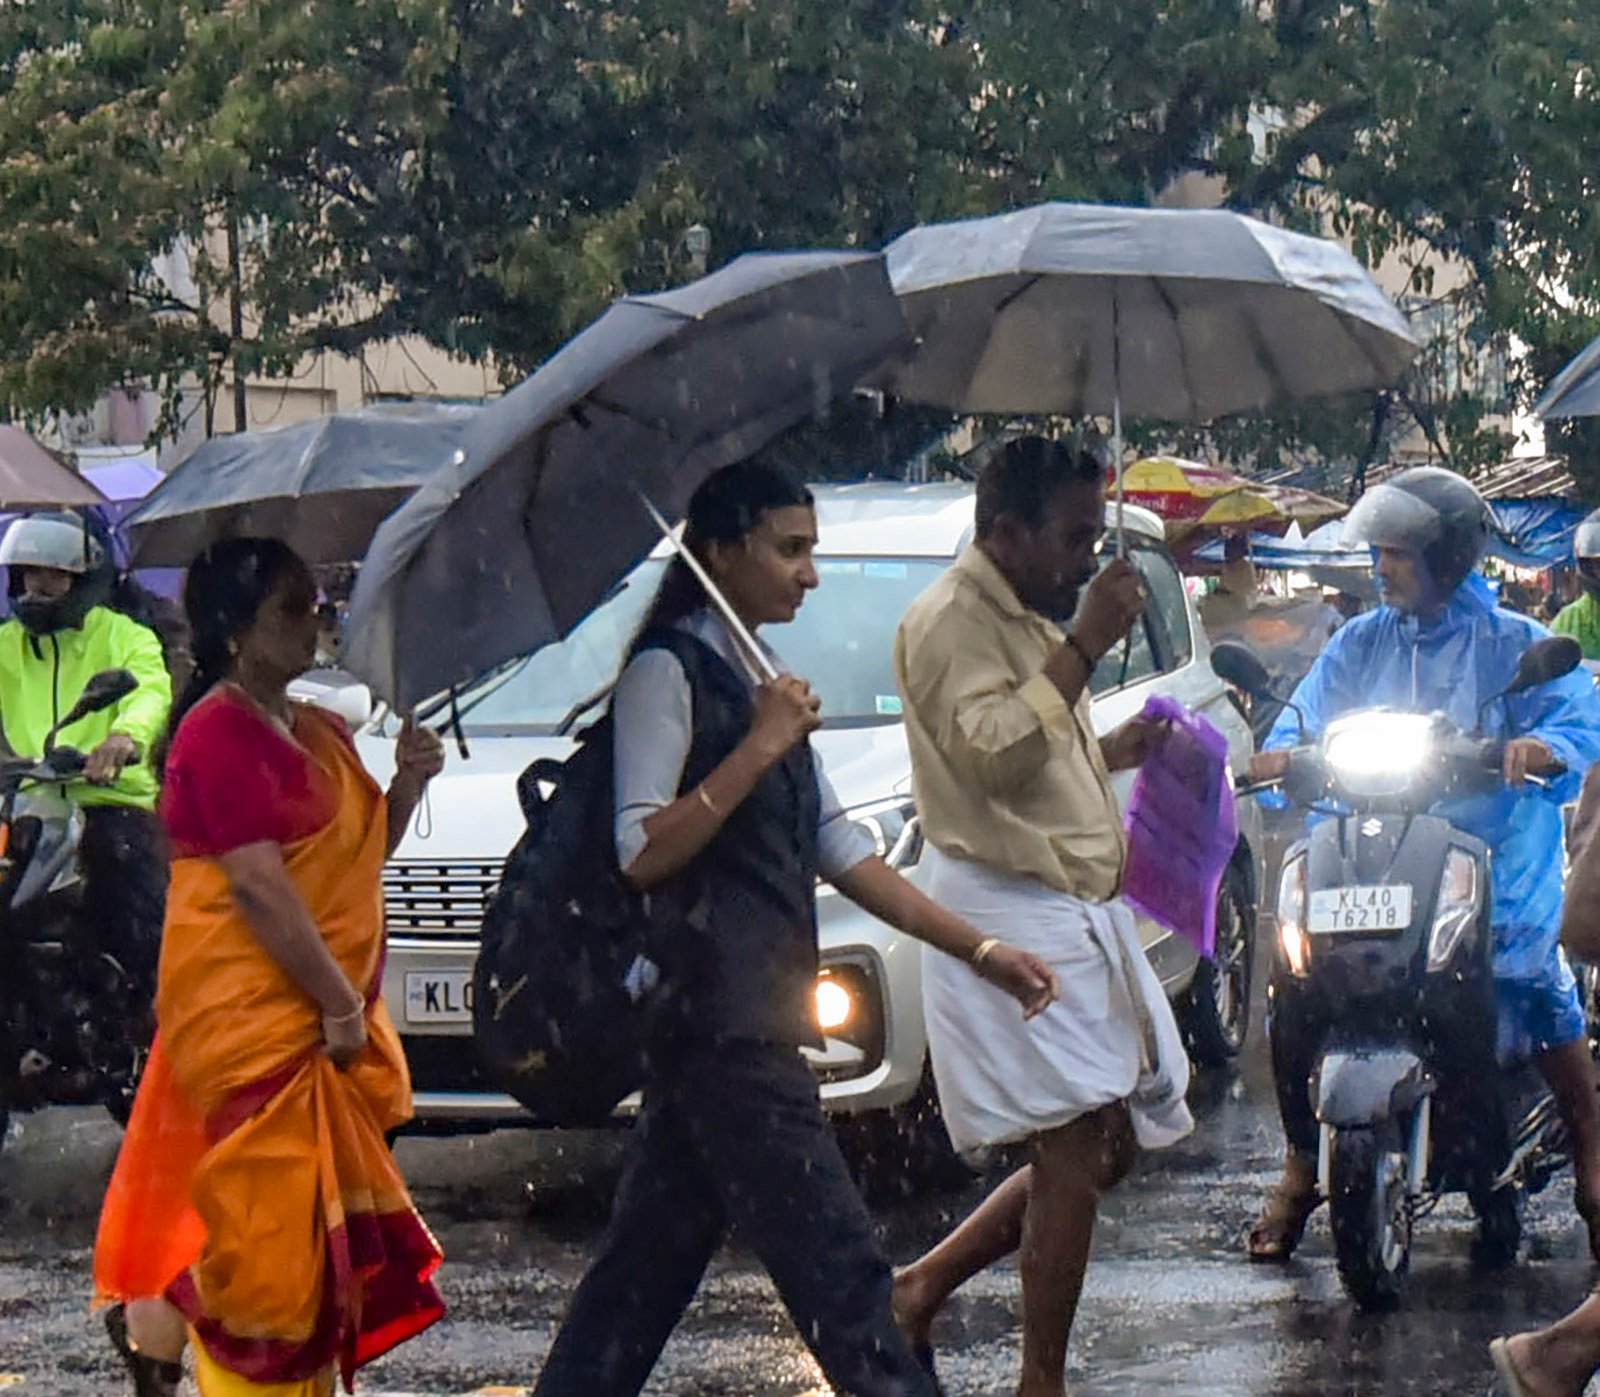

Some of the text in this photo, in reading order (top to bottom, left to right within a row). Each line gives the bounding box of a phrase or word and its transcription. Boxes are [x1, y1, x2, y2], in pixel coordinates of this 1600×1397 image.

[1338, 888, 1392, 909] KL 40
[1331, 906, 1397, 928] T6218
